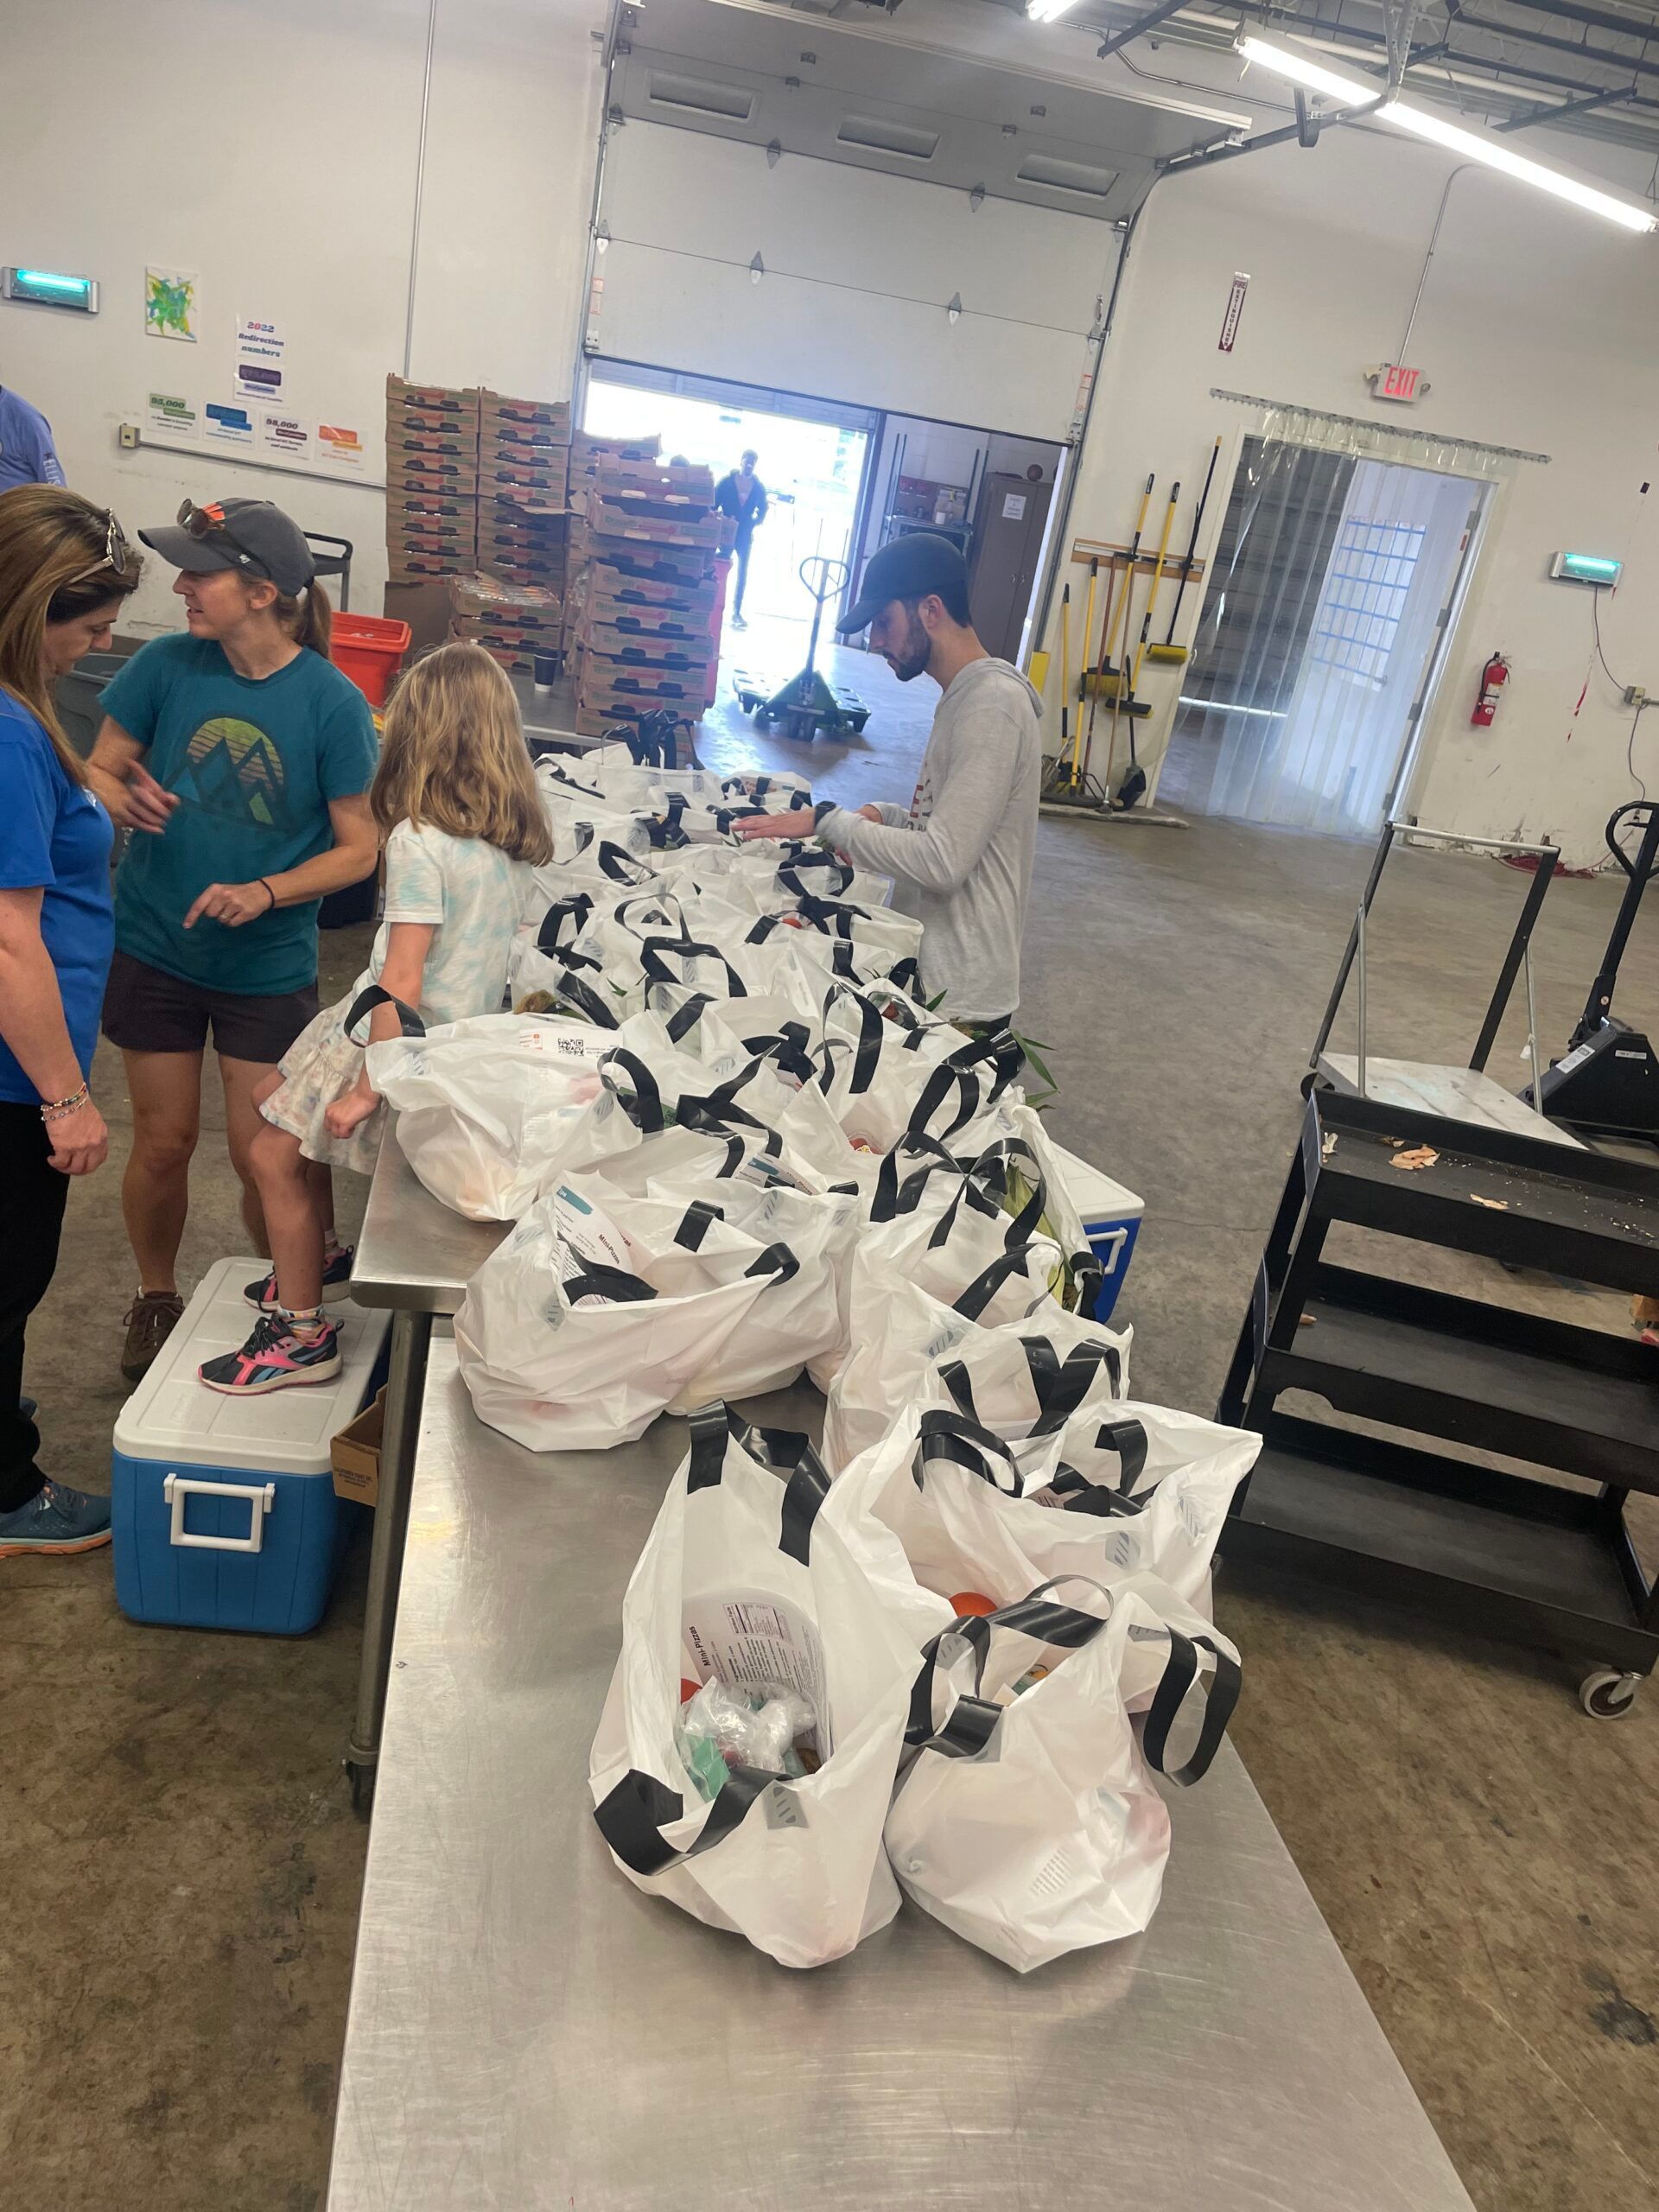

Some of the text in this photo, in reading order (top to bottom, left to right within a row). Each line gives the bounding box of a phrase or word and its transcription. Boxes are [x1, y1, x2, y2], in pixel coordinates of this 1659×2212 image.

[247, 321, 275, 333] 2022
[1224, 289, 1241, 346] EXTINGUISHER
[238, 333, 284, 346] Redirection
[241, 345, 281, 358] numbers
[1384, 366, 1420, 398] EXIT
[597, 1234, 620, 1265] Mini-Pizzas
[689, 1625, 711, 1667] Mini-Pizzas
